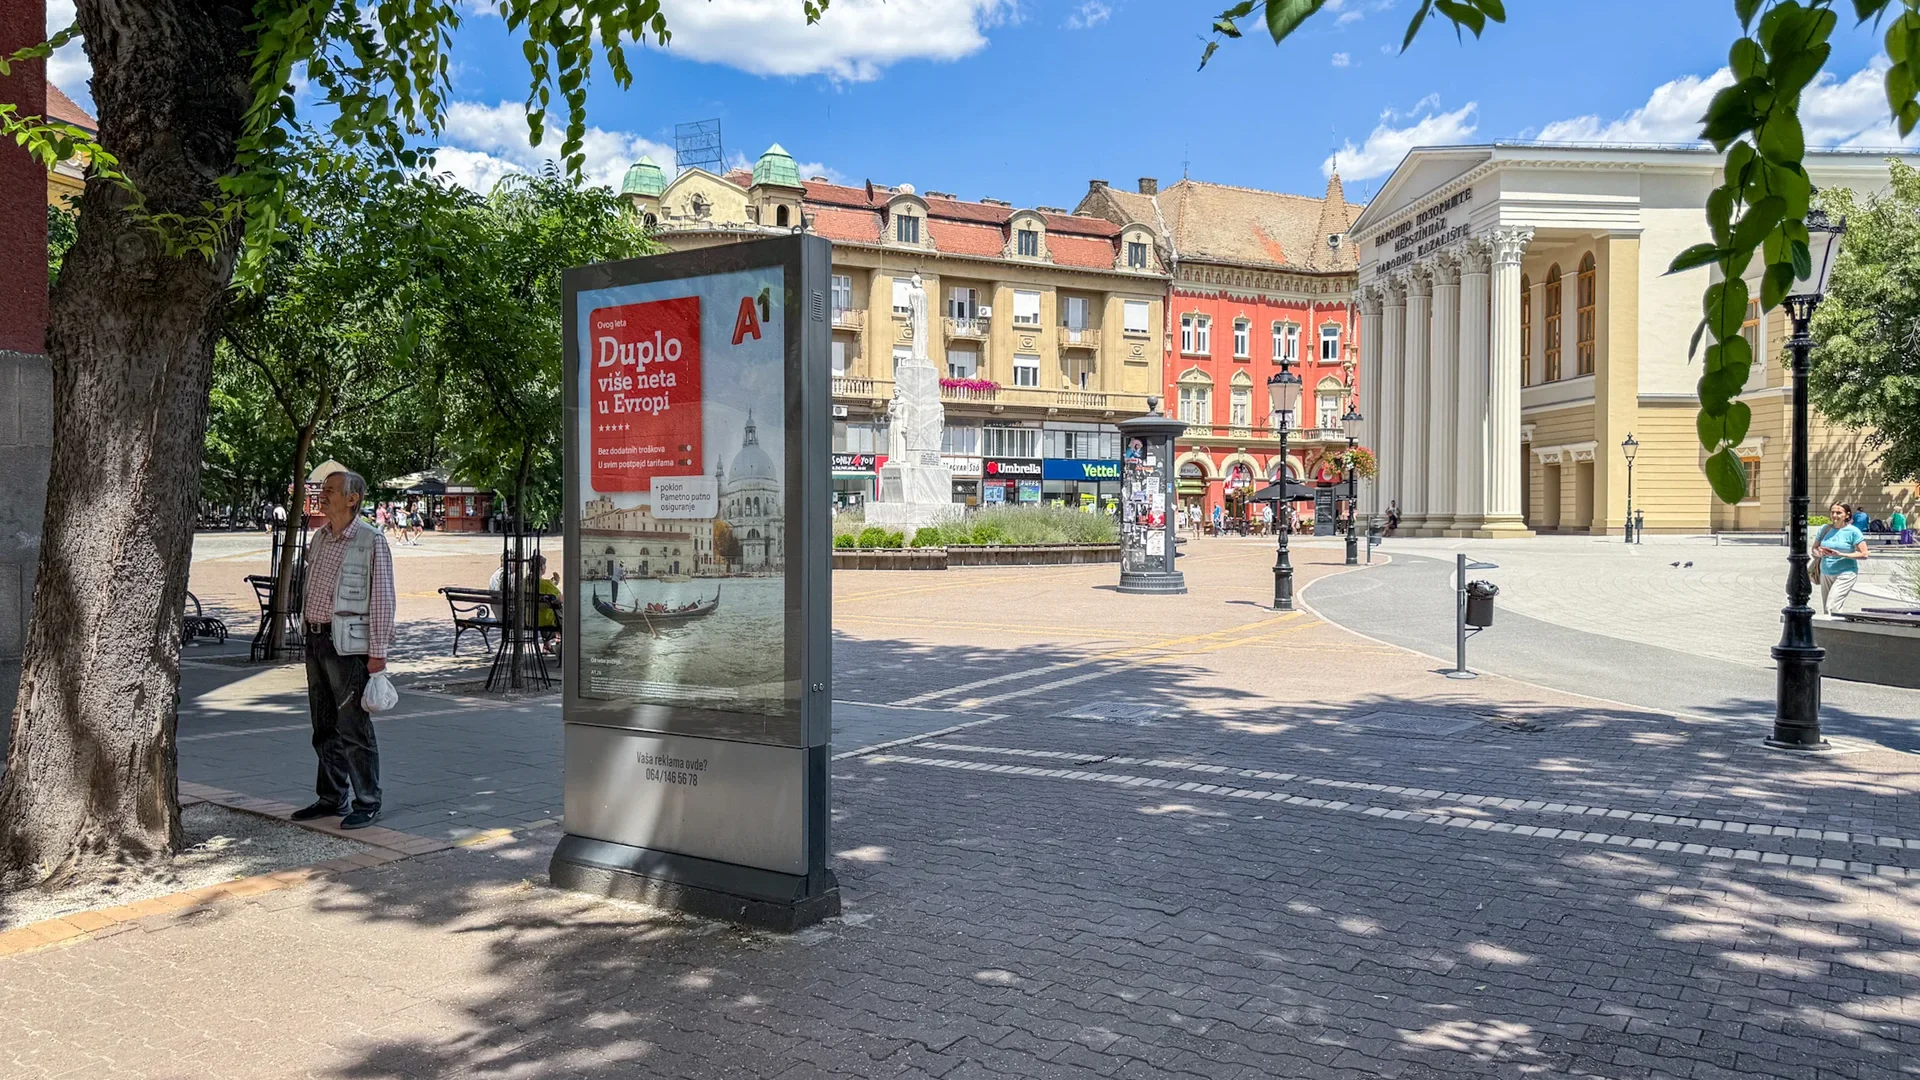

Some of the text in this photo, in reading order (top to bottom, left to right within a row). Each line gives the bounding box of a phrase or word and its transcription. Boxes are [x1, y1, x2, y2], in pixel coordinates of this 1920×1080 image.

[1375, 187, 1473, 248] НАРОДНО ПОЗОРИШТЕ
[1376, 223, 1470, 276] NARODNO KAZALIŠTE
[597, 319, 627, 330] Ovog leta
[731, 287, 770, 345] A1
[598, 330, 682, 372] Duplo
[598, 369, 676, 392] više neta
[598, 391, 670, 416] u Evropi
[598, 444, 666, 456] Bez dodatnih troškova
[598, 458, 674, 470] U svim postpejd tarifama
[997, 463, 1041, 474] Umbrella
[660, 483, 683, 492] poklon
[660, 492, 711, 502] Pametno putno
[660, 502, 696, 513] osiguranje
[636, 751, 708, 771] Vaša reklama ovde?
[645, 768, 698, 787] 064/146 56 78
